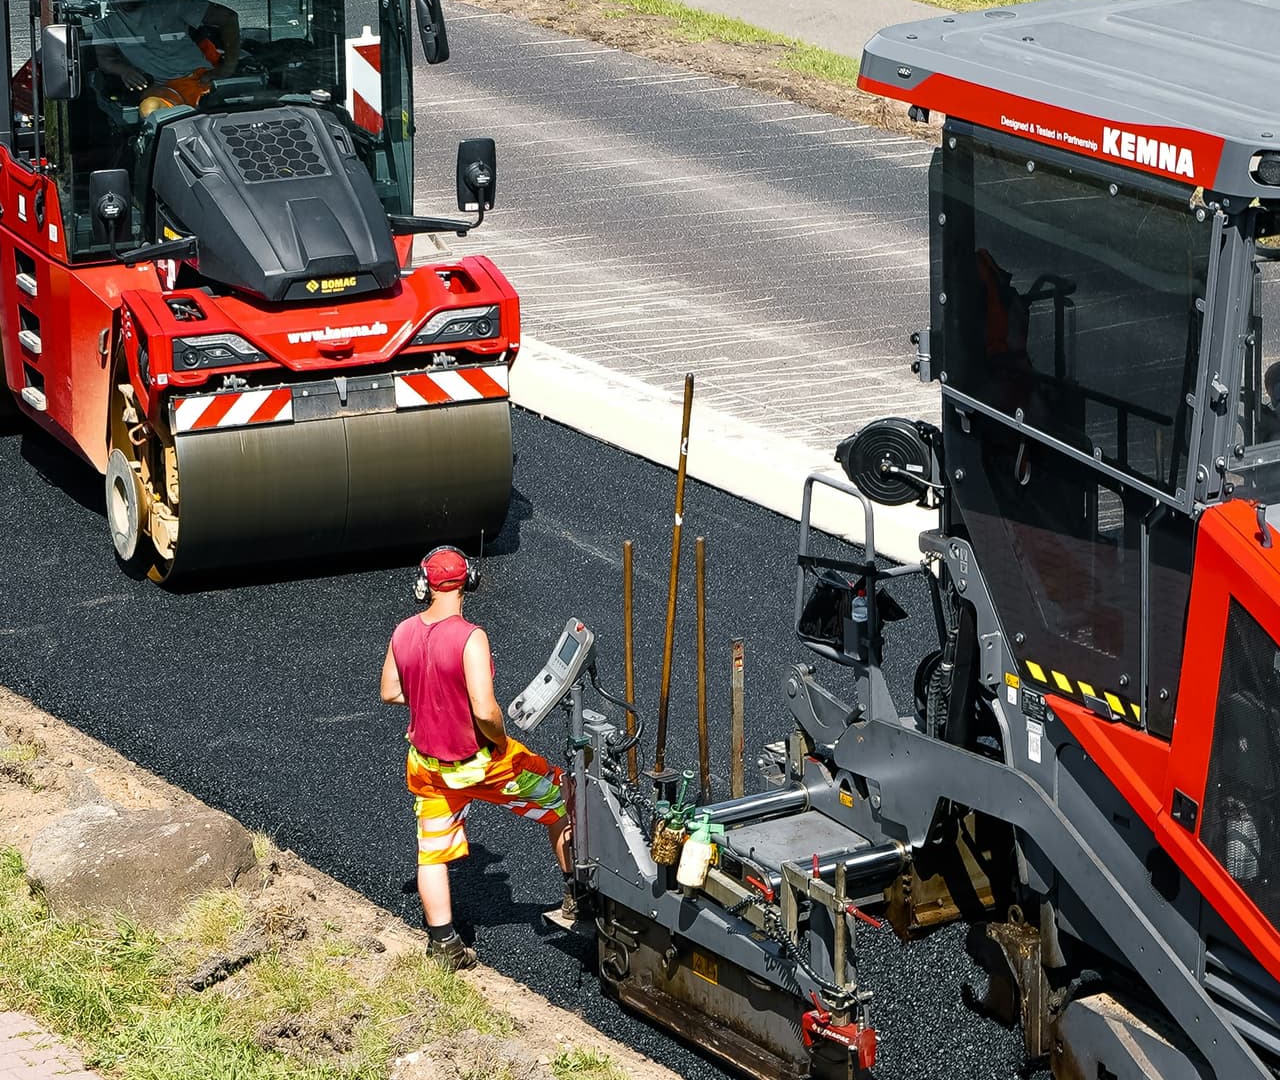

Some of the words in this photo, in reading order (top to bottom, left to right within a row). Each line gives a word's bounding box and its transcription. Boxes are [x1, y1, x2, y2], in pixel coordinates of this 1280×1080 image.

[1000, 115, 1029, 131] Designed
[1036, 124, 1056, 139] Tested
[1063, 132, 1098, 152] Partnership
[1102, 126, 1195, 178] KEMNA
[321, 277, 356, 290] BOMAG
[287, 321, 388, 344] www.kemna.de
